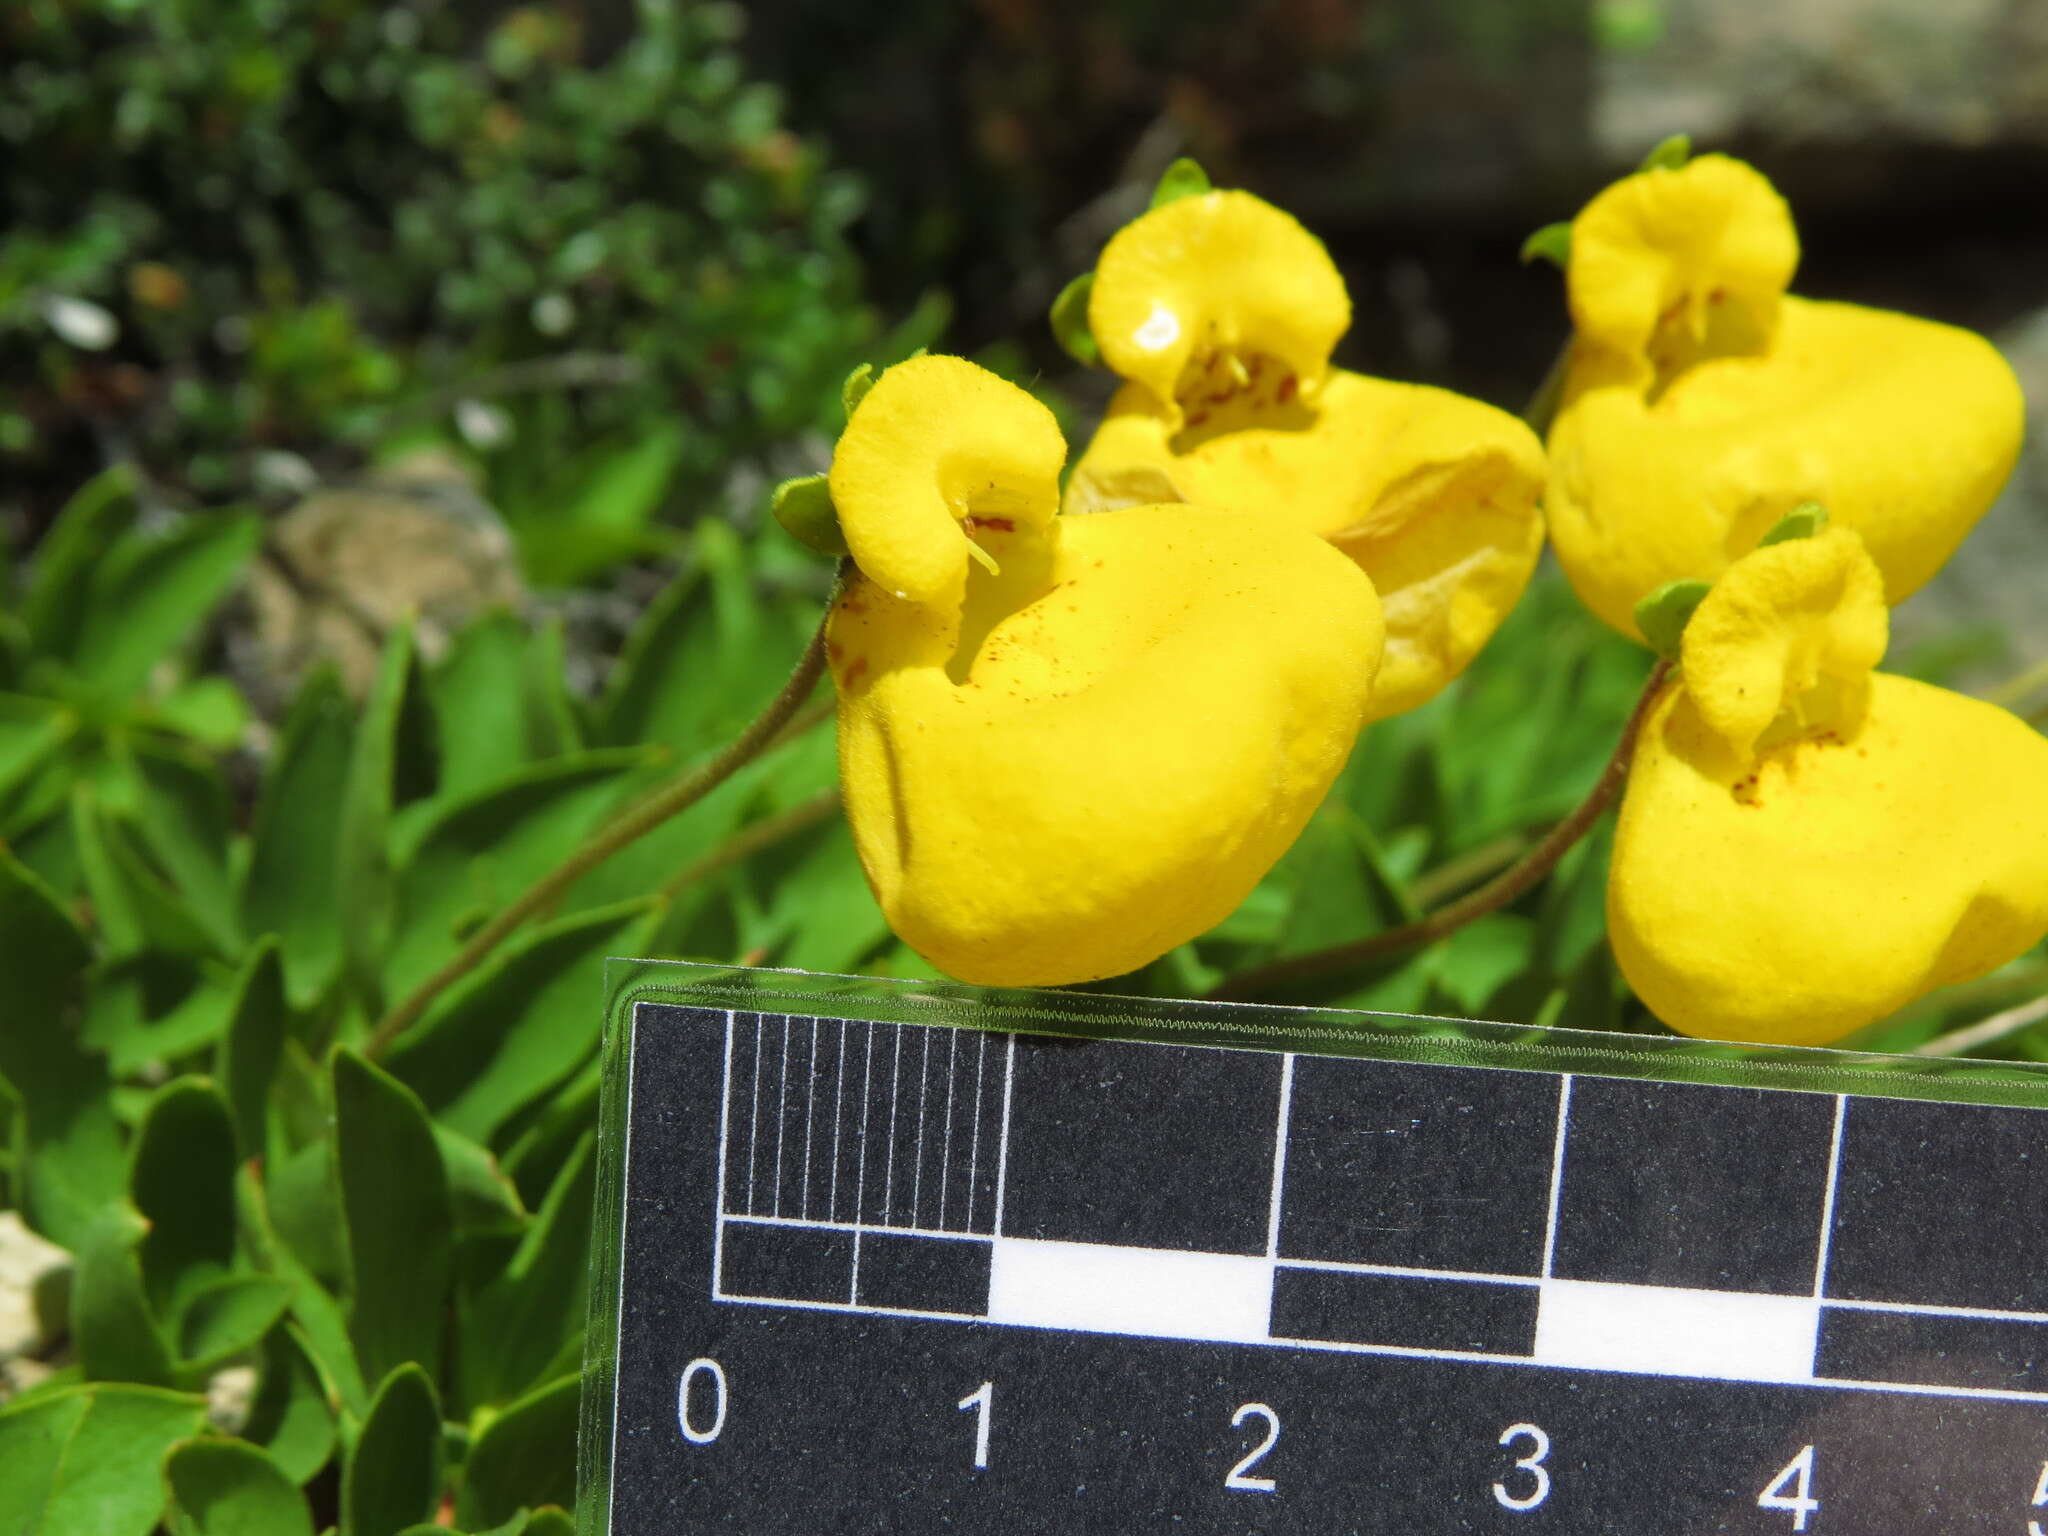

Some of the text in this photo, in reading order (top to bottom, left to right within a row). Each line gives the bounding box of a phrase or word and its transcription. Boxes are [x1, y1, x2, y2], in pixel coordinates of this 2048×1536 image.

[677, 1357, 1819, 1531] 0 1 2 3 4
